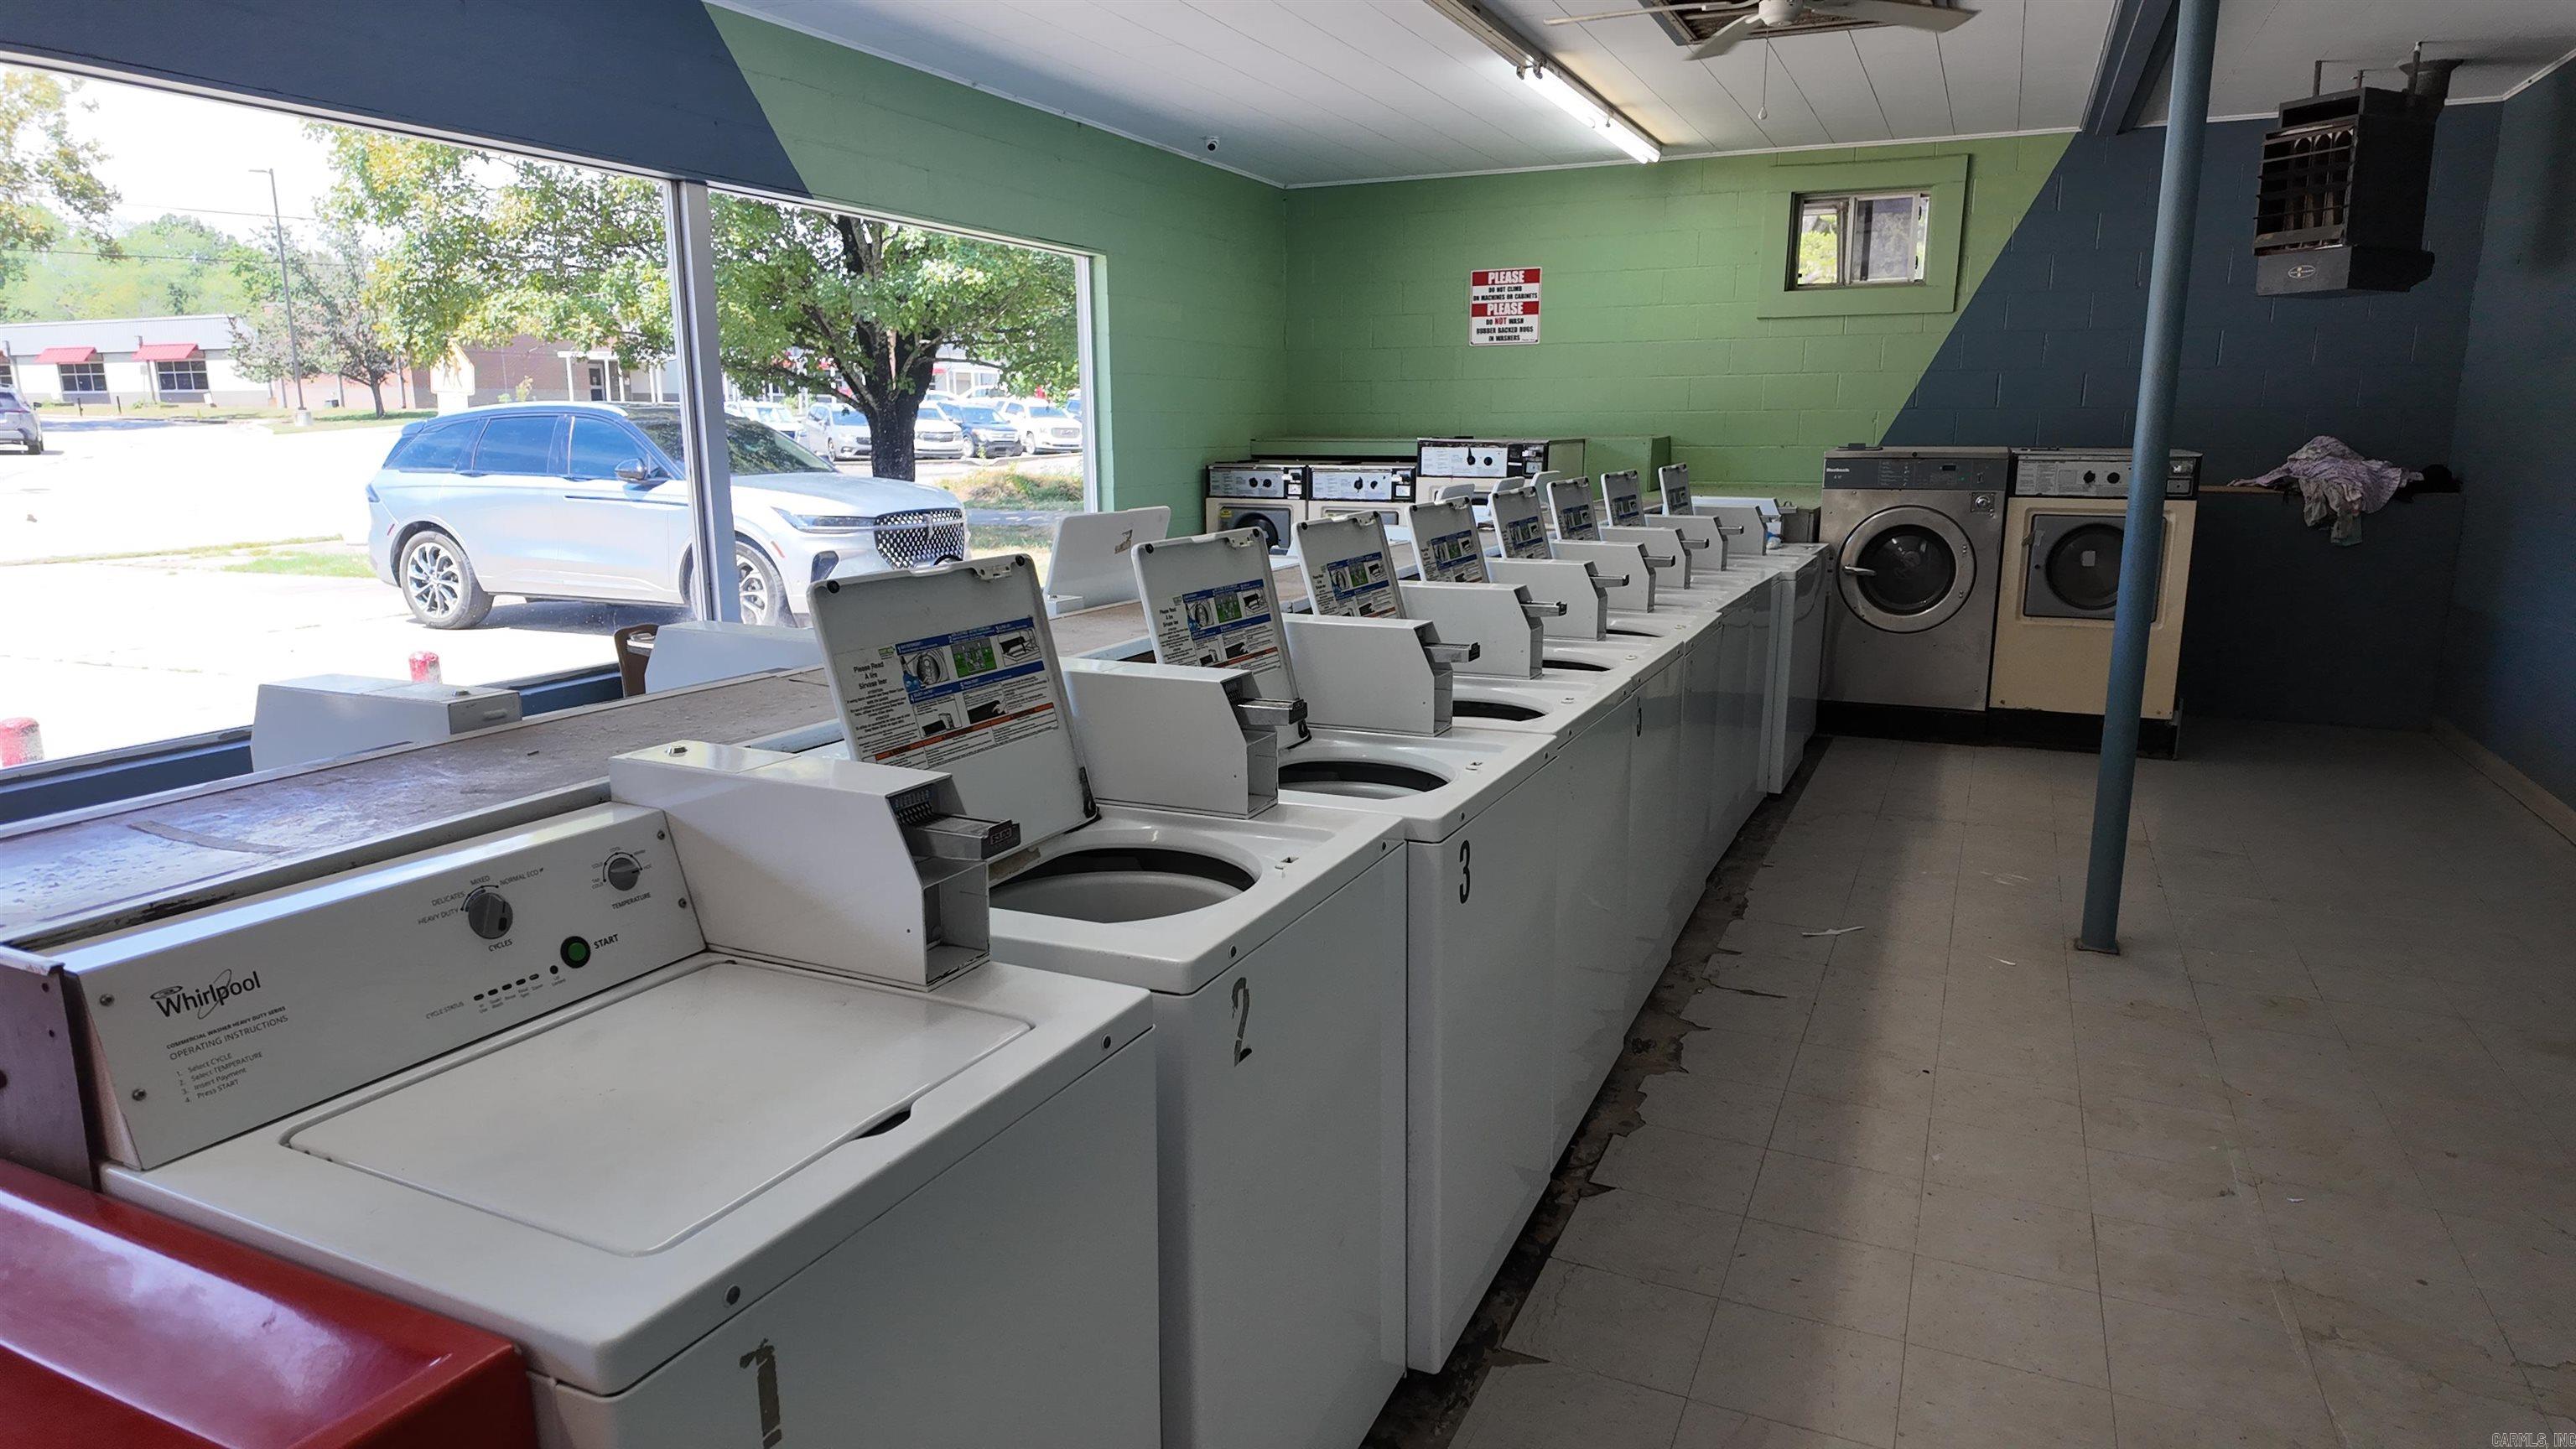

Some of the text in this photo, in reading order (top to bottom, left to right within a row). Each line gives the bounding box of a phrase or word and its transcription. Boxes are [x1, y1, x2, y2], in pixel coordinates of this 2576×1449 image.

[1488, 271, 1524, 284] PLEASE
[1487, 302, 1524, 315] PLEASE
[470, 875, 491, 886] MIXED
[500, 870, 539, 886] NORMAL ECO
[1459, 839, 1470, 904] 3
[431, 891, 465, 906] DELICATES
[418, 907, 459, 925] HEAVY DUTY
[488, 938, 513, 953] CYCLES
[594, 933, 619, 949] START
[156, 970, 262, 1018] Whirlpool
[167, 1005, 286, 1050] COMMERCIAL WASHER HEAVY DUTY SERIES
[1231, 977, 1252, 1067] 2
[169, 1015, 288, 1060] OPERATING INSTRUCTIONS
[188, 1061, 210, 1073] Select
[210, 1052, 232, 1066] CYCLE
[191, 1070, 213, 1082] Select
[214, 1051, 262, 1074] TEMPERATURE
[194, 1078, 215, 1090] Insert
[216, 1067, 247, 1083] Payment
[197, 1088, 217, 1099] Press
[217, 1078, 239, 1092] START
[740, 1337, 782, 1449] 1
